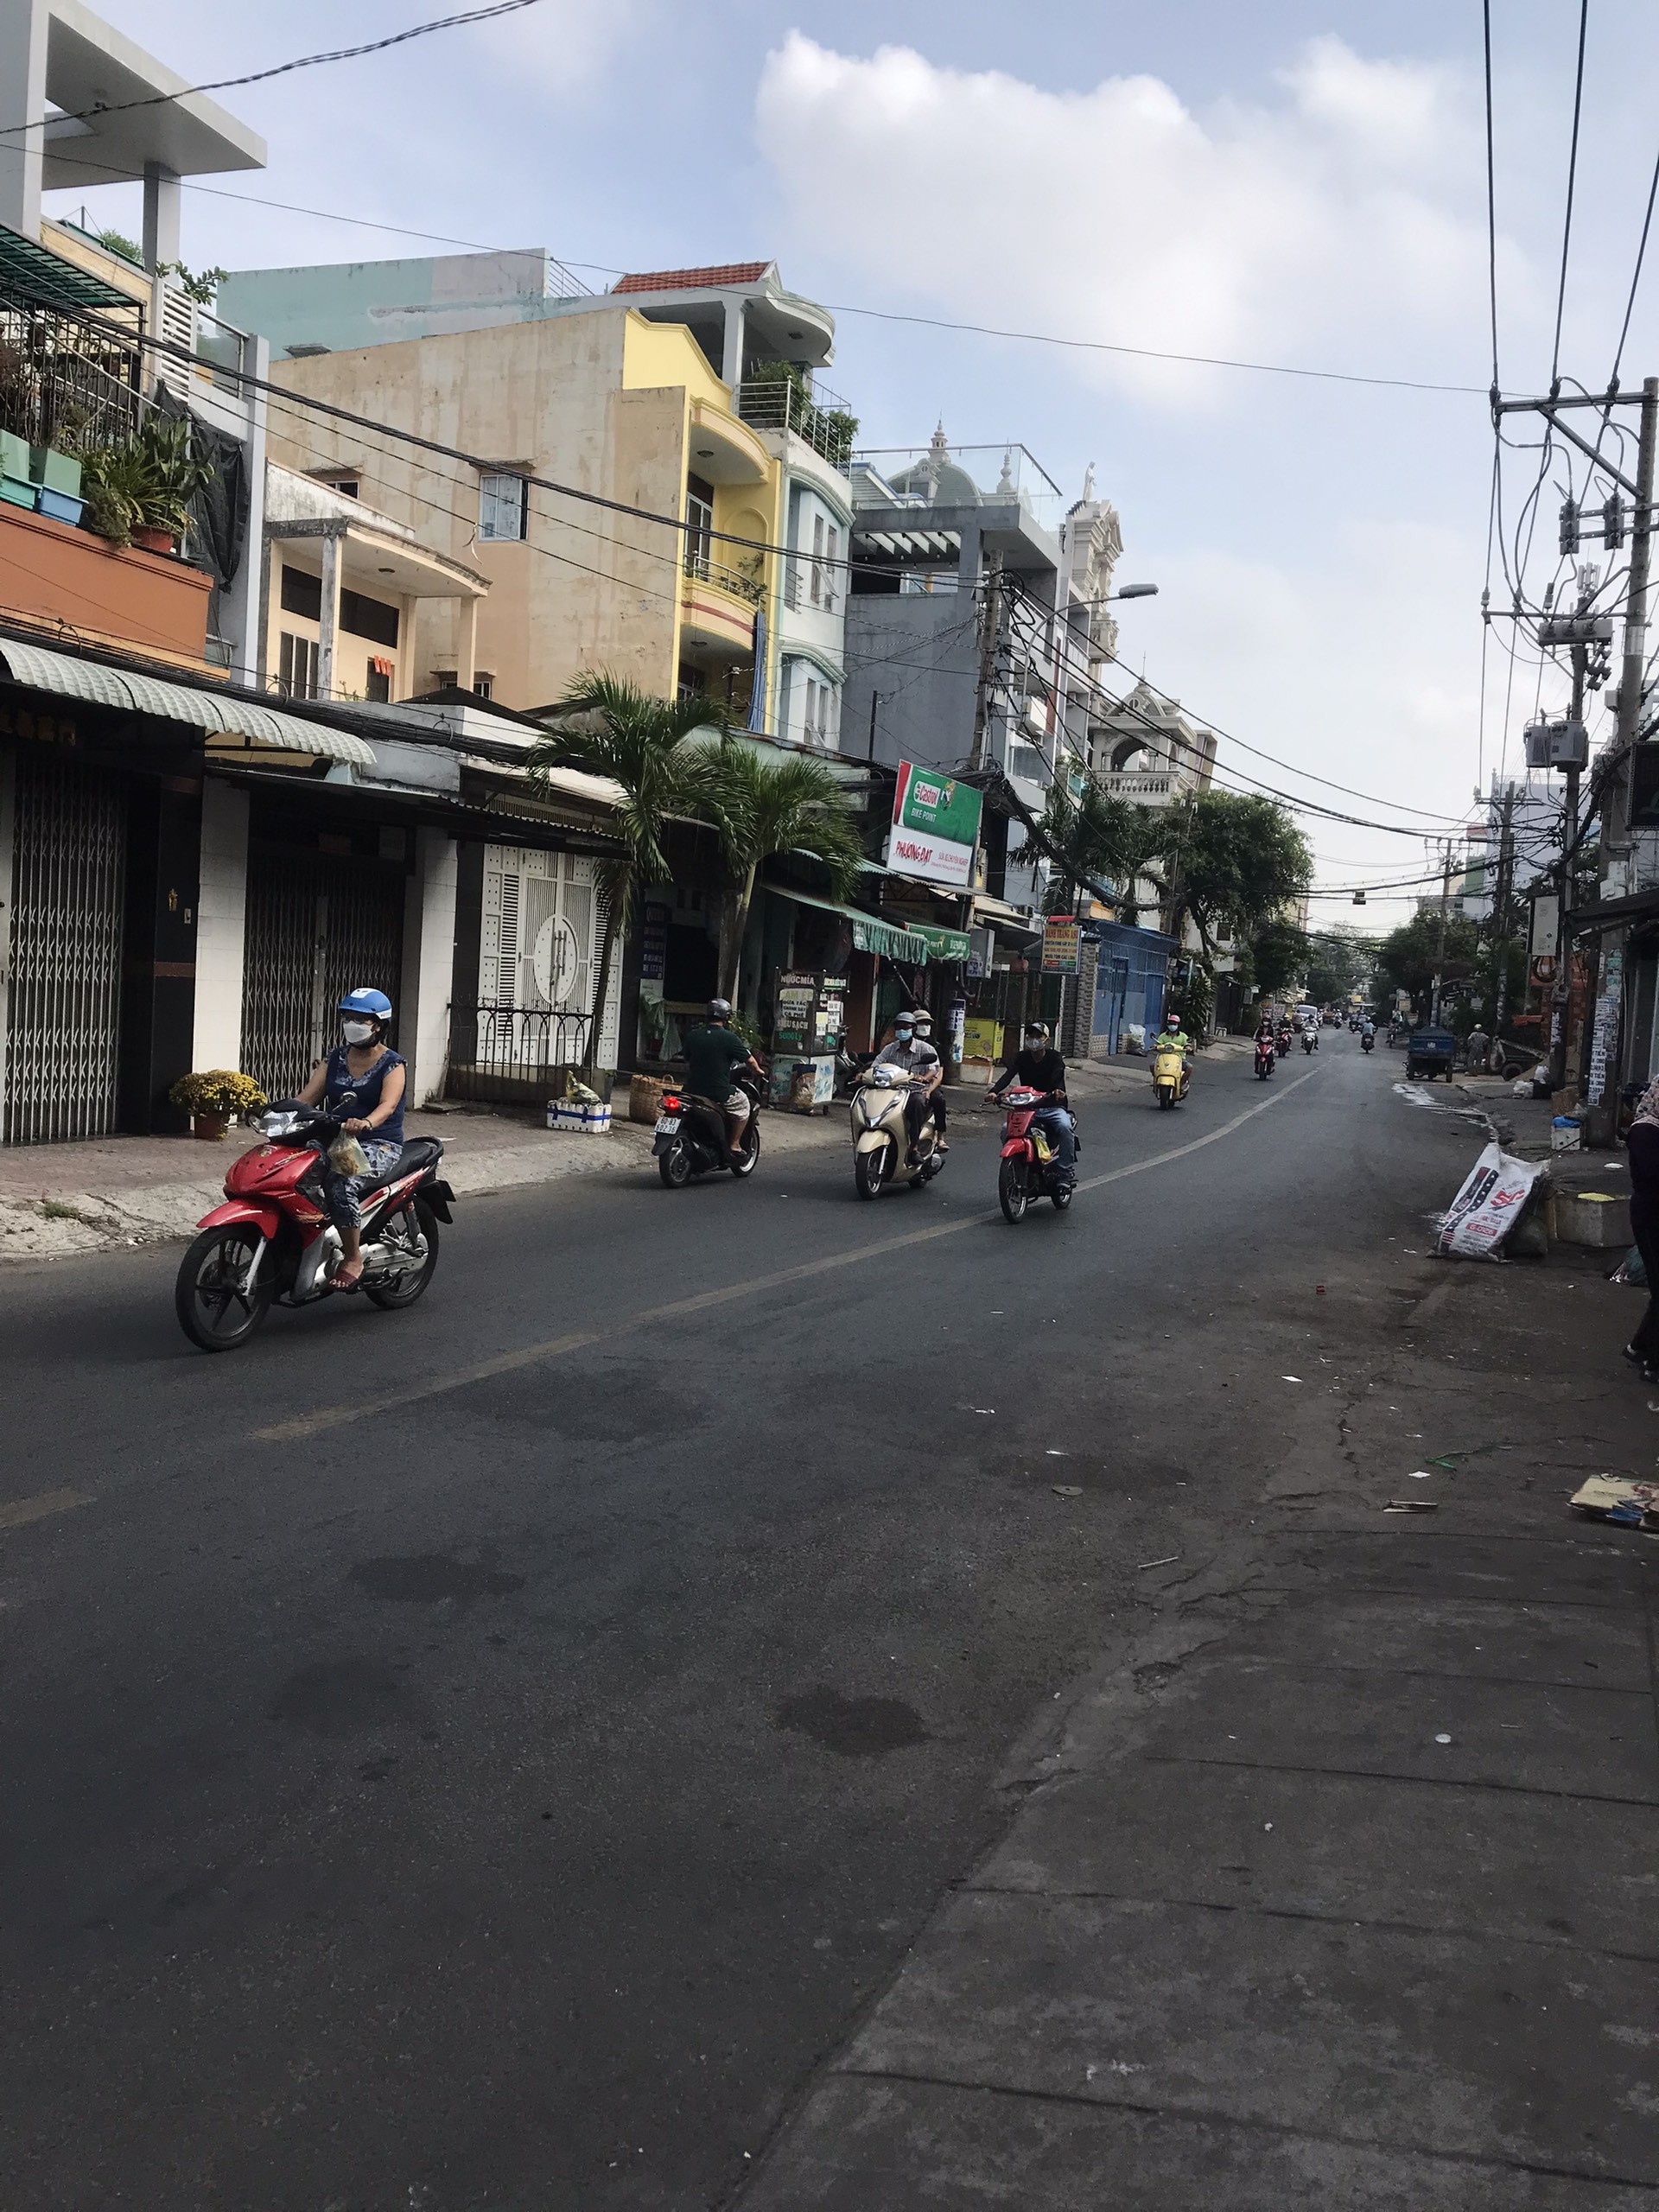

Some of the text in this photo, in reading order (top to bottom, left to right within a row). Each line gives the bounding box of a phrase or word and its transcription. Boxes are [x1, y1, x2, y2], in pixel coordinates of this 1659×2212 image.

[919, 785, 938, 804] Castrol
[911, 808, 937, 823] BIKE POINT
